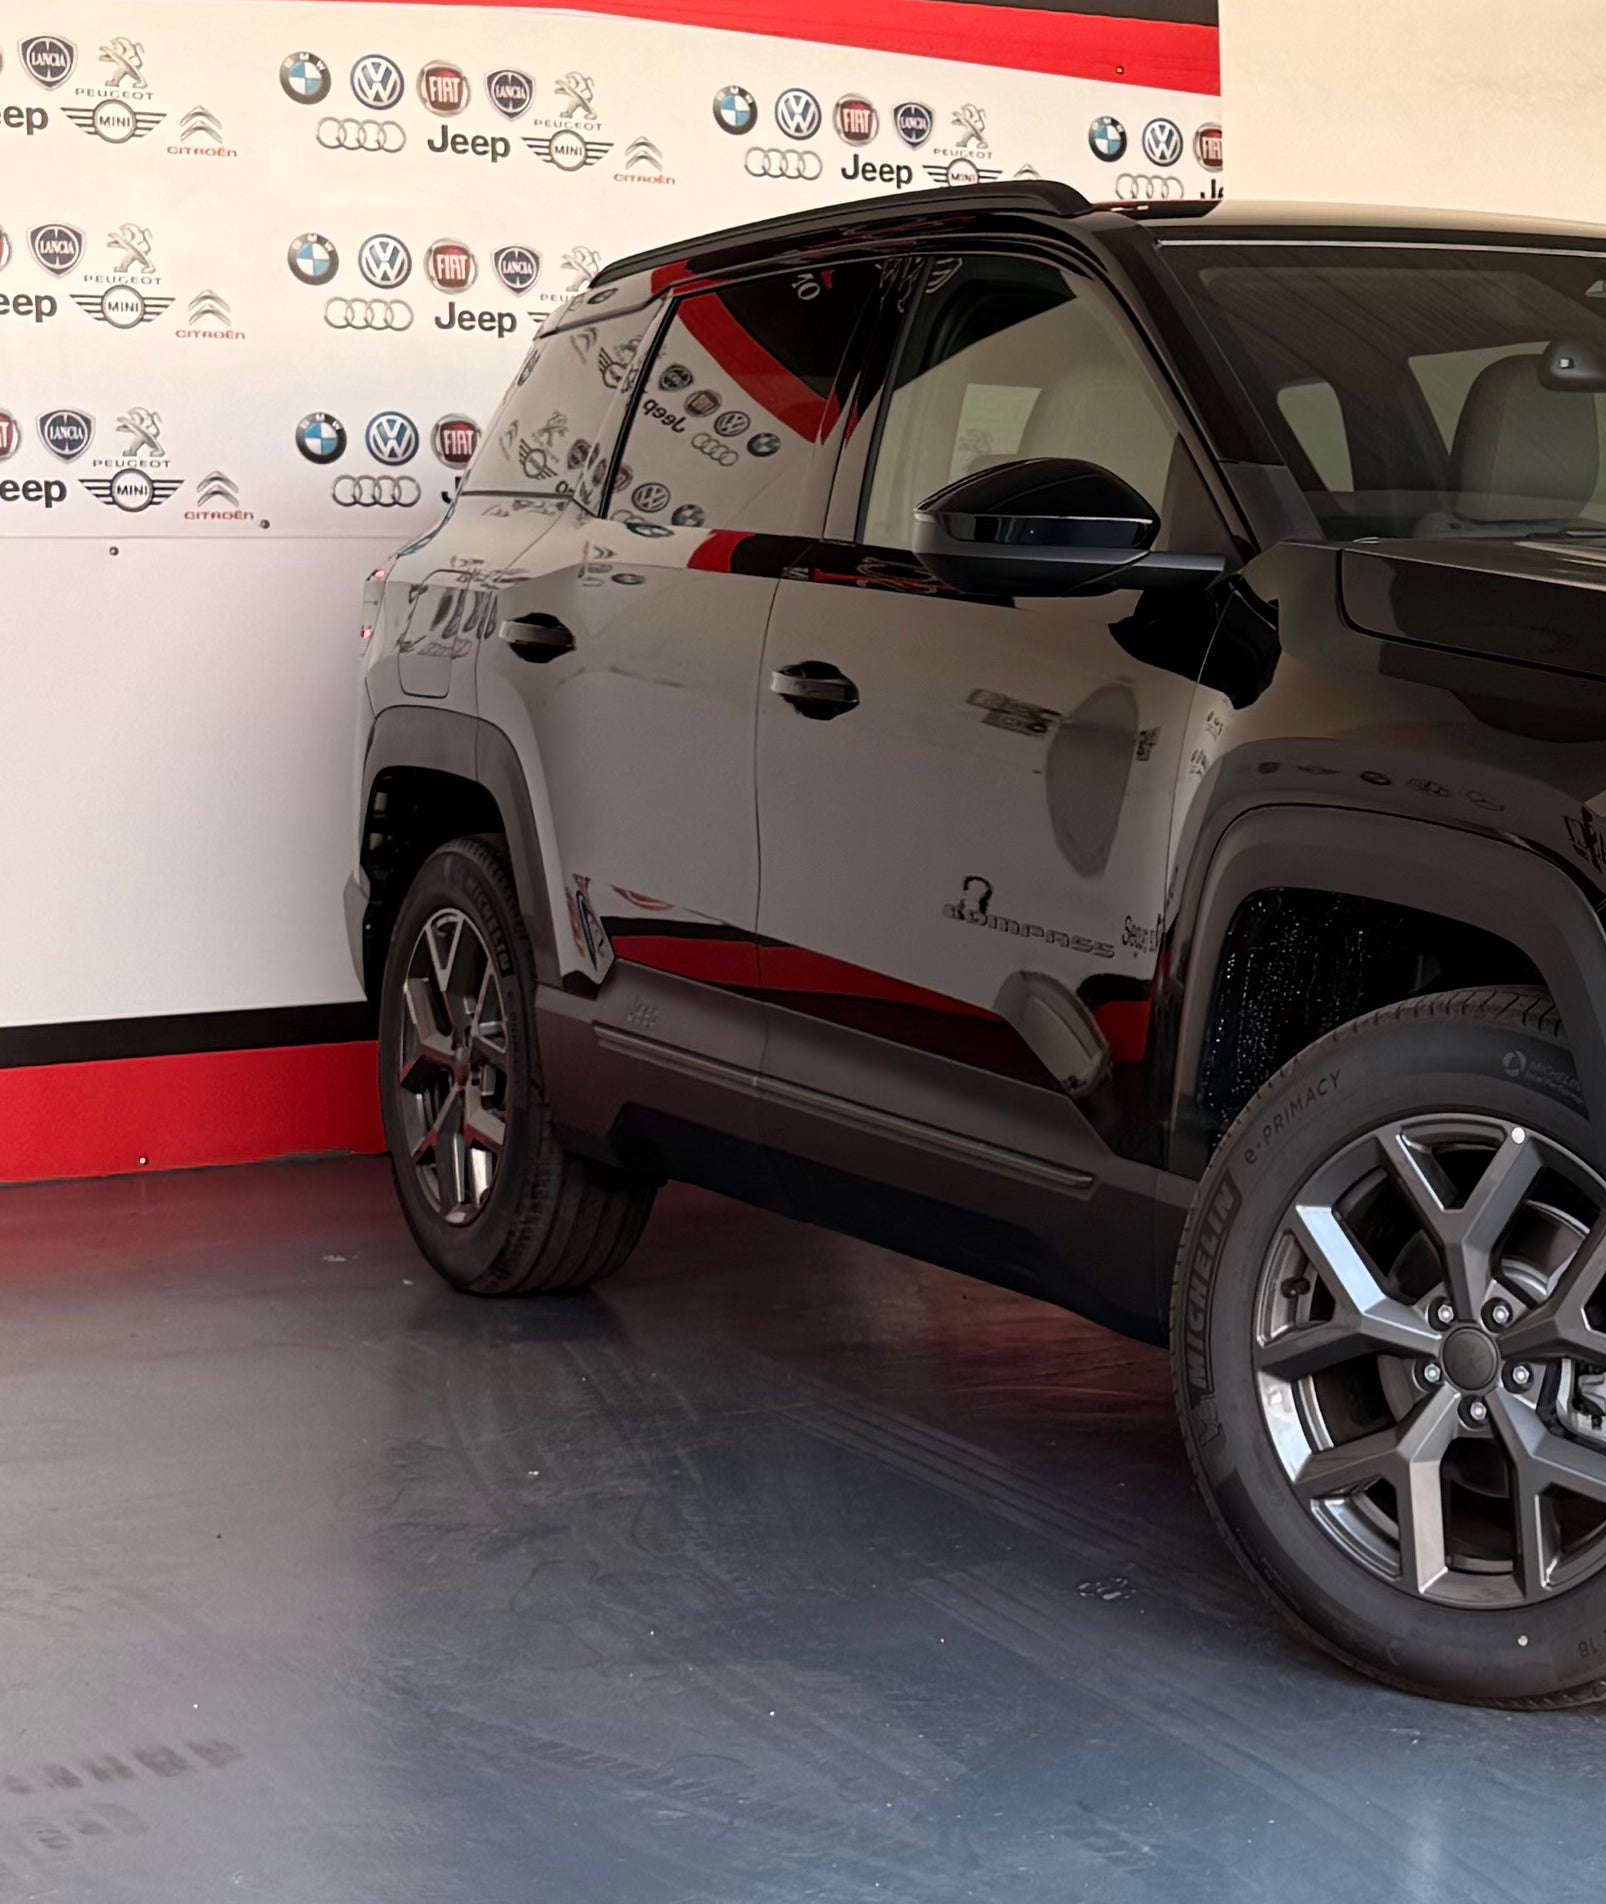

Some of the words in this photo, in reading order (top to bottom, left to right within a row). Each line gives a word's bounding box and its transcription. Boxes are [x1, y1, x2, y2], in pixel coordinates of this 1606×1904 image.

[75, 87, 155, 100] PEUGEOT
[428, 76, 461, 104] FIAT
[0, 105, 49, 135] ep
[99, 115, 131, 128] MINI
[534, 118, 603, 131] PEUGEOT
[843, 108, 871, 134] FIAT
[427, 124, 511, 163] Jeep
[554, 145, 583, 157] MINI
[1202, 137, 1223, 159] FIA
[841, 153, 913, 189] Jeep
[83, 274, 163, 285] PEUGEOT
[436, 254, 468, 280] FIAT
[0, 293, 58, 323] eep
[107, 301, 139, 313] MINI
[434, 301, 517, 338] Jeep
[442, 430, 475, 455] FIAT
[93, 458, 171, 469] PEUGEOT
[0, 478, 67, 508] eep
[116, 483, 148, 496] MINI
